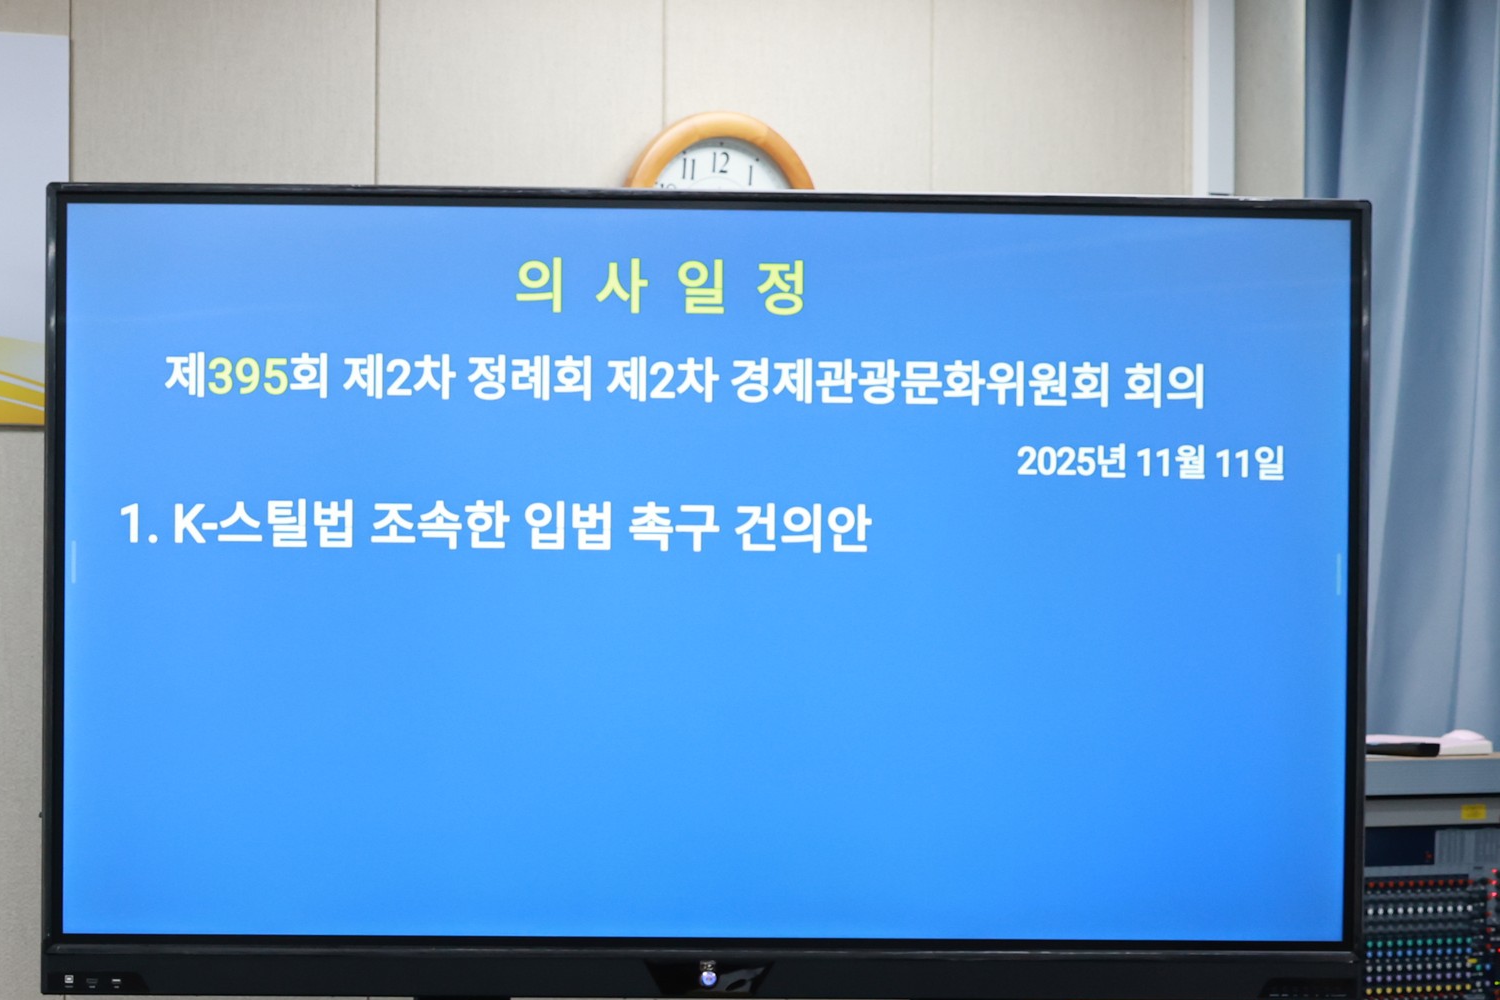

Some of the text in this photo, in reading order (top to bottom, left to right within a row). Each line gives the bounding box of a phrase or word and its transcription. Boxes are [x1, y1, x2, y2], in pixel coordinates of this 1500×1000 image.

[682, 157, 696, 180] 11
[712, 151, 731, 174] 12
[748, 164, 753, 186] 1
[164, 351, 1204, 410] 제395회 제2차 정례회 제2차 경제관광문화위원회 회의
[1017, 443, 1284, 481] 2025년 11월 11일
[120, 498, 873, 554] 1. K-스틸법 조속한 입법 촉구 건의안
